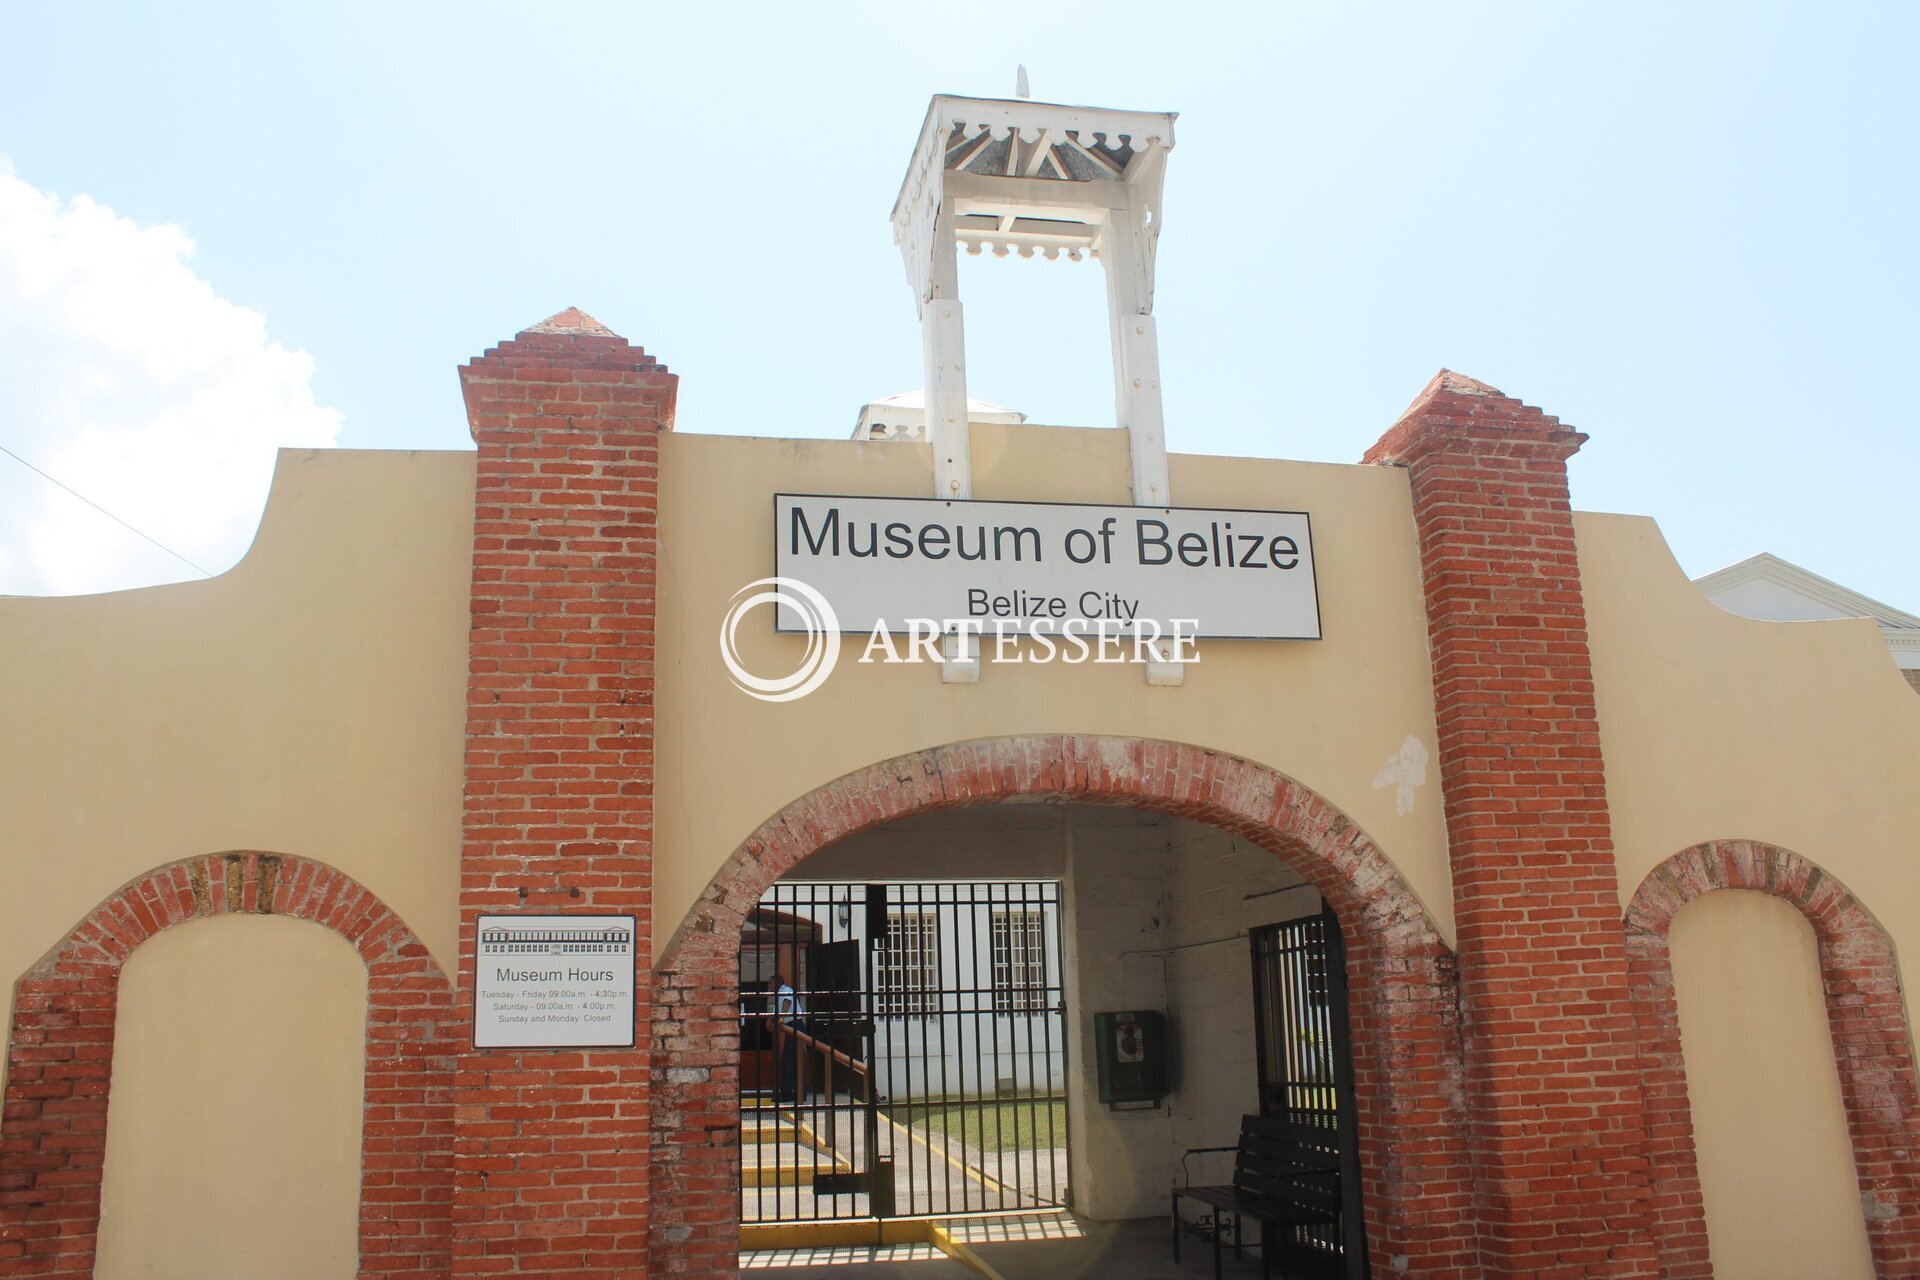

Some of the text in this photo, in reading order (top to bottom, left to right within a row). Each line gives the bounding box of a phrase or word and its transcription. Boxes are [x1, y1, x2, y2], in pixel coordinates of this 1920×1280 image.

[790, 507, 1299, 570] Museum of Belize
[968, 588, 1139, 627] Belize City
[496, 968, 614, 982] Museum Hours
[481, 990, 515, 999] Tuesday
[522, 990, 547, 999] Friday
[493, 1002, 529, 1011] Saturday
[498, 1015, 529, 1023] Sunday
[583, 1014, 611, 1022] Closed
